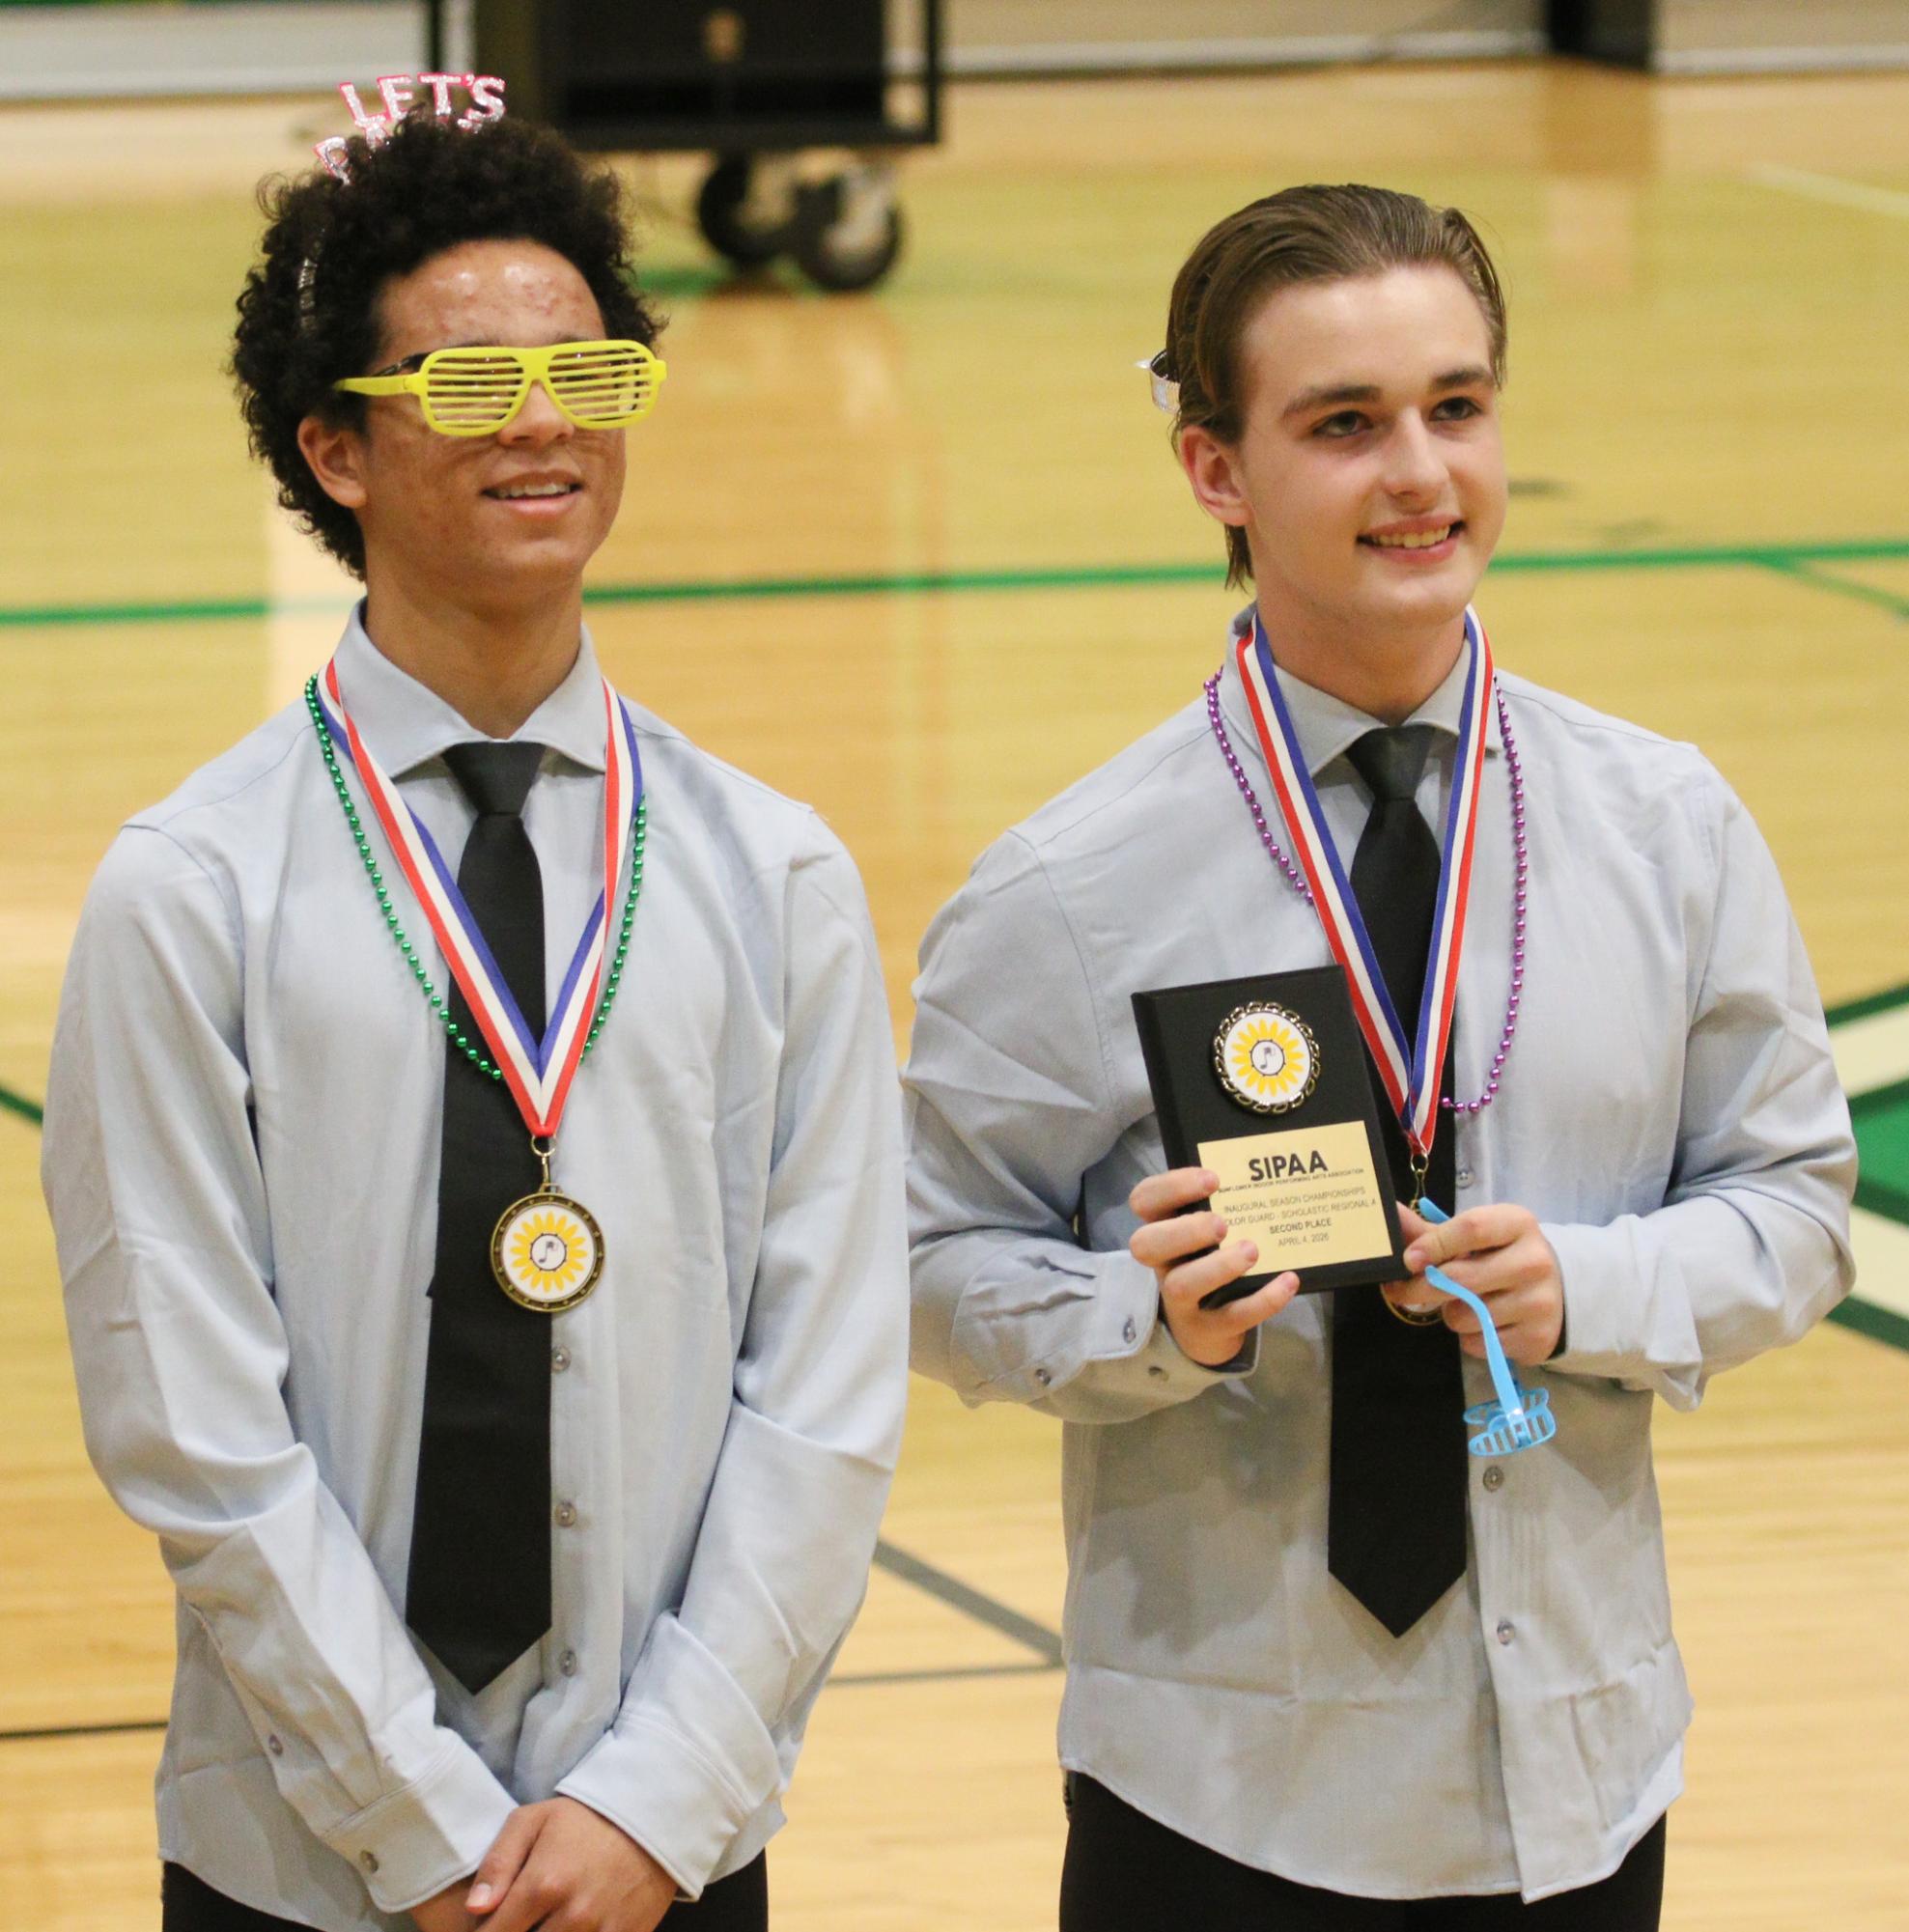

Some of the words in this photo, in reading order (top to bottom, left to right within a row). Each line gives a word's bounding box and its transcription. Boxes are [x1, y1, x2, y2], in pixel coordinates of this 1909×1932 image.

[337, 70, 506, 132] LET'S
[1249, 1150, 1329, 1182] SIPAA
[1224, 1201, 1267, 1213] INAUGURAL
[1270, 1195, 1302, 1207] SEASON
[1303, 1186, 1366, 1202] CHAMPIONSHIPS
[1226, 1217, 1246, 1226] OLOR
[1248, 1213, 1276, 1223] GUARD
[1281, 1206, 1330, 1219] SCHOLASTIC
[1331, 1198, 1369, 1211] REGIONAL
[1269, 1221, 1304, 1234] SECOND
[1305, 1217, 1333, 1229] PLACE
[1278, 1236, 1302, 1246] APRIL
